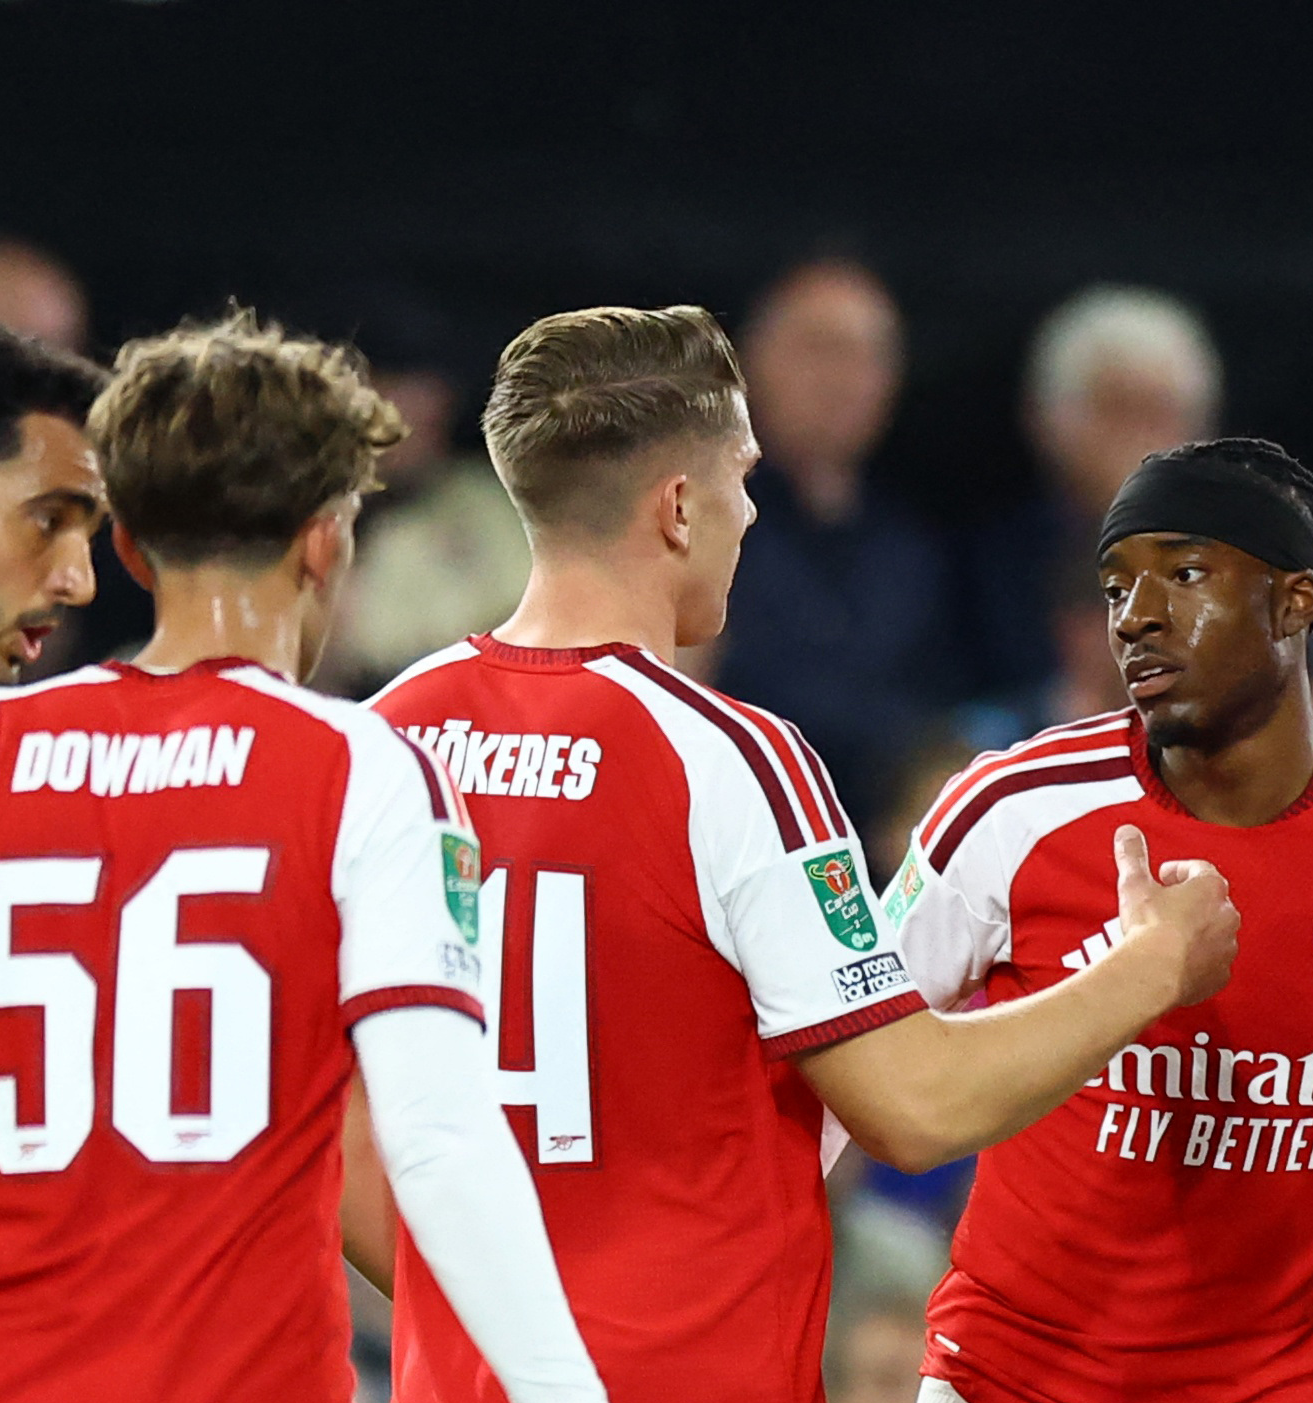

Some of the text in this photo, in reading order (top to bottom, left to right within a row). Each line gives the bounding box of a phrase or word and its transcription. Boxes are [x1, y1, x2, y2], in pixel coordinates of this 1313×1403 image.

[11, 725, 256, 797] DOWMAN
[832, 956, 899, 990] No room
[839, 980, 866, 1003] for
[1096, 1102, 1173, 1162] FLY
